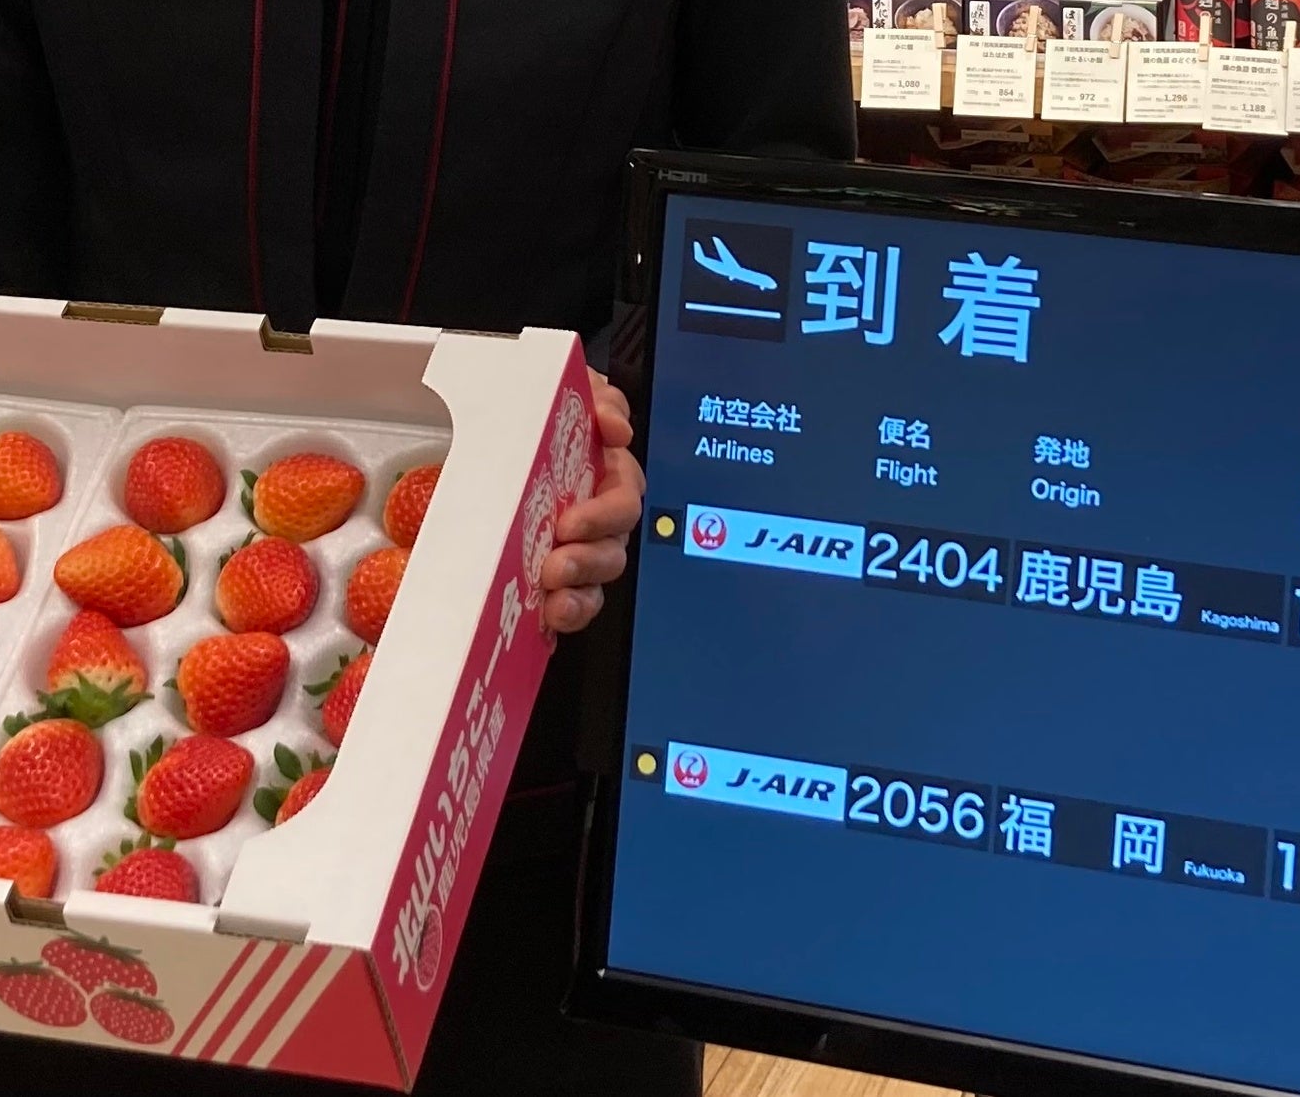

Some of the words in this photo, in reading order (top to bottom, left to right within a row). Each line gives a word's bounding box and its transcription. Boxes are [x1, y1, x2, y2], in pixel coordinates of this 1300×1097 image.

[1079, 94, 1096, 102] 972
[1164, 93, 1188, 102] 1,296
[1241, 103, 1266, 113] 1,188
[658, 169, 708, 183] HDMI
[698, 394, 802, 434] 航空会社
[878, 415, 932, 450] 便名
[1033, 435, 1091, 470] 発地
[695, 436, 775, 465] Airlines
[876, 458, 938, 486] Flight
[1030, 477, 1101, 508] Origin
[744, 528, 854, 560] J-AIR
[866, 532, 1004, 592] 2404
[1015, 548, 1183, 623] 鹿児島
[1201, 608, 1280, 633] Kagoshima
[725, 767, 836, 802] J-AIR
[848, 776, 985, 839] 2056
[1184, 860, 1245, 884] Fukuoka
